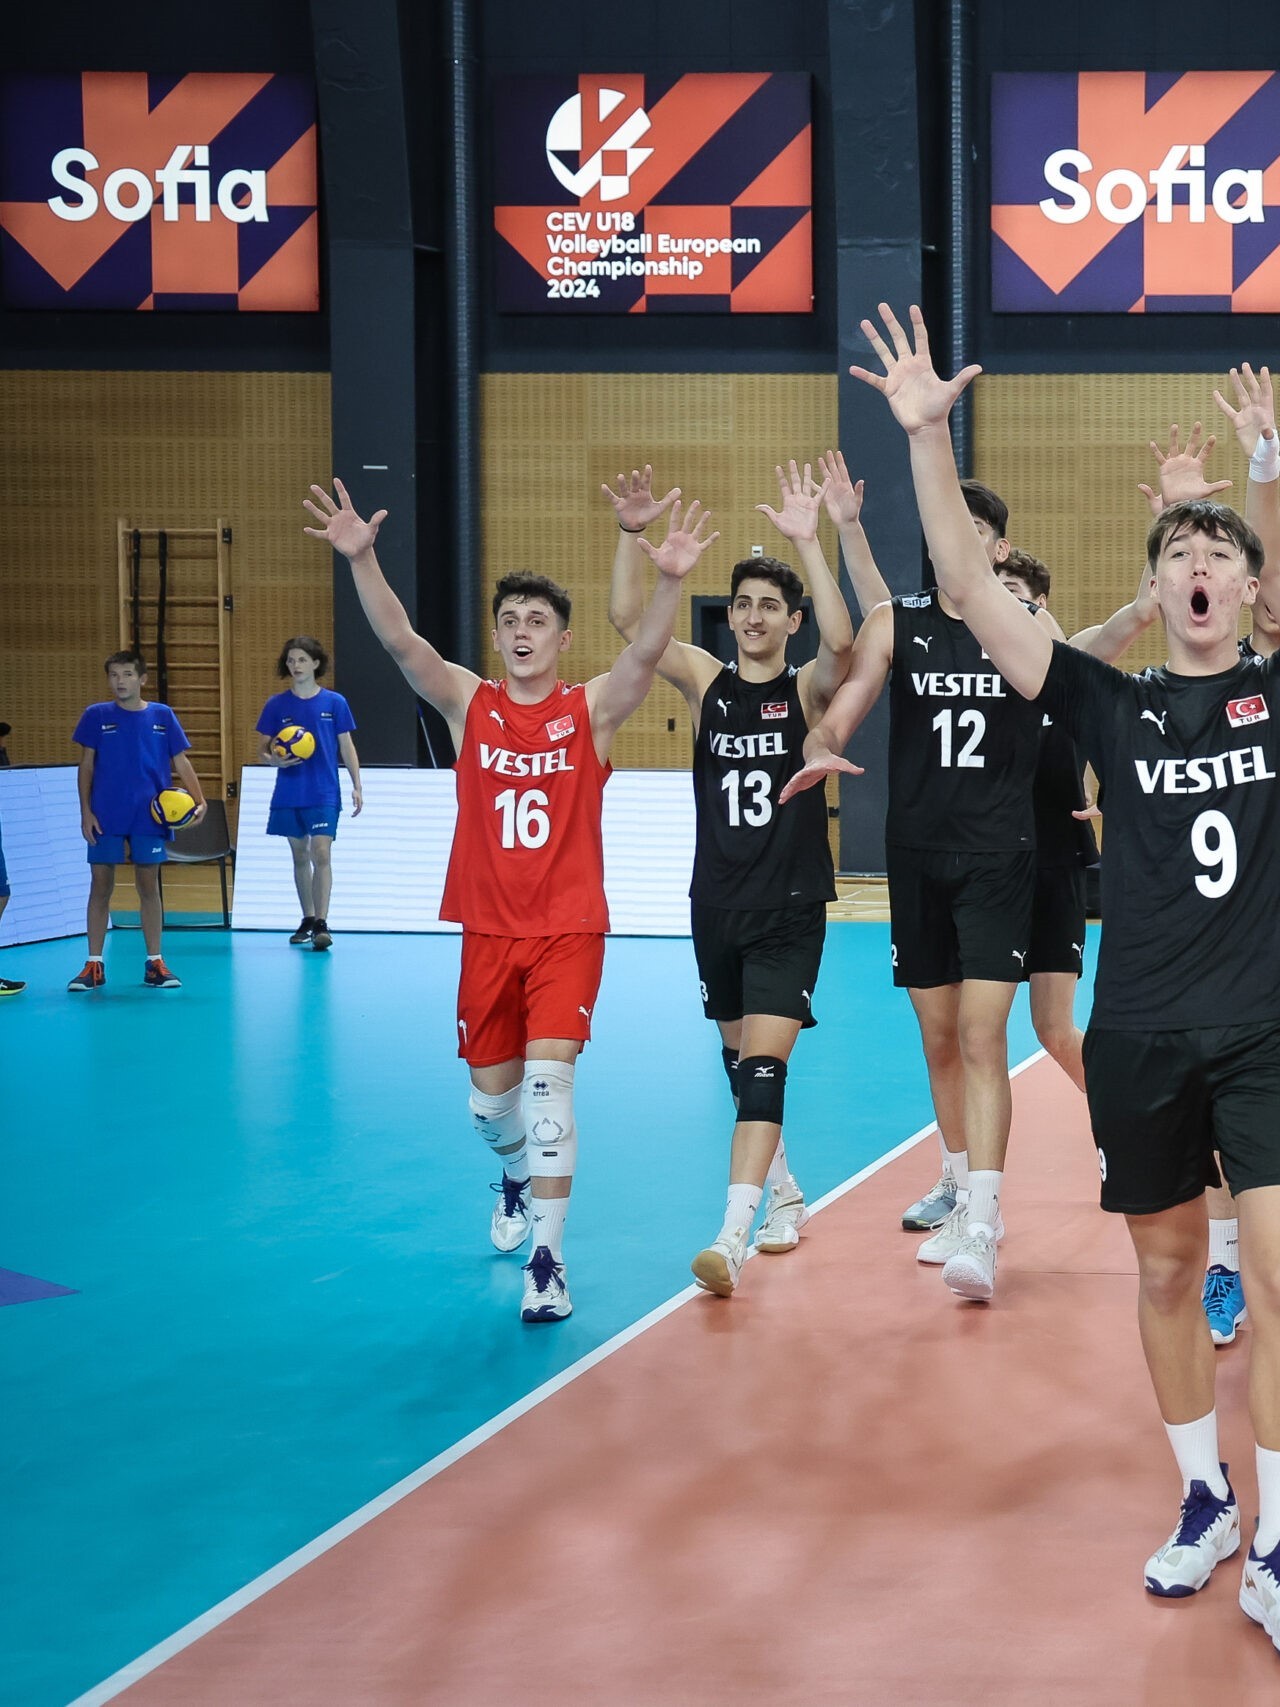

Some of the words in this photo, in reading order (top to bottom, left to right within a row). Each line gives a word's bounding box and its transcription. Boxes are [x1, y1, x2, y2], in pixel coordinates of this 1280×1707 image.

[48, 145, 269, 223] Sofia
[1039, 145, 1265, 224] Sofia
[546, 212, 591, 231] CEV
[597, 212, 635, 231] U18
[546, 233, 652, 257] Volleyball
[657, 234, 761, 257] European
[546, 256, 704, 280] Championship
[546, 278, 600, 298] 2024
[911, 672, 1007, 697] VESTEL
[1240, 715, 1260, 724] TUR
[709, 729, 788, 759] VESTEL
[932, 708, 986, 768] 12
[479, 743, 574, 777] VESTEL
[1134, 746, 1276, 794] VESTEL
[721, 769, 772, 827] 13
[494, 788, 550, 849] 16
[1191, 809, 1238, 899] 9
